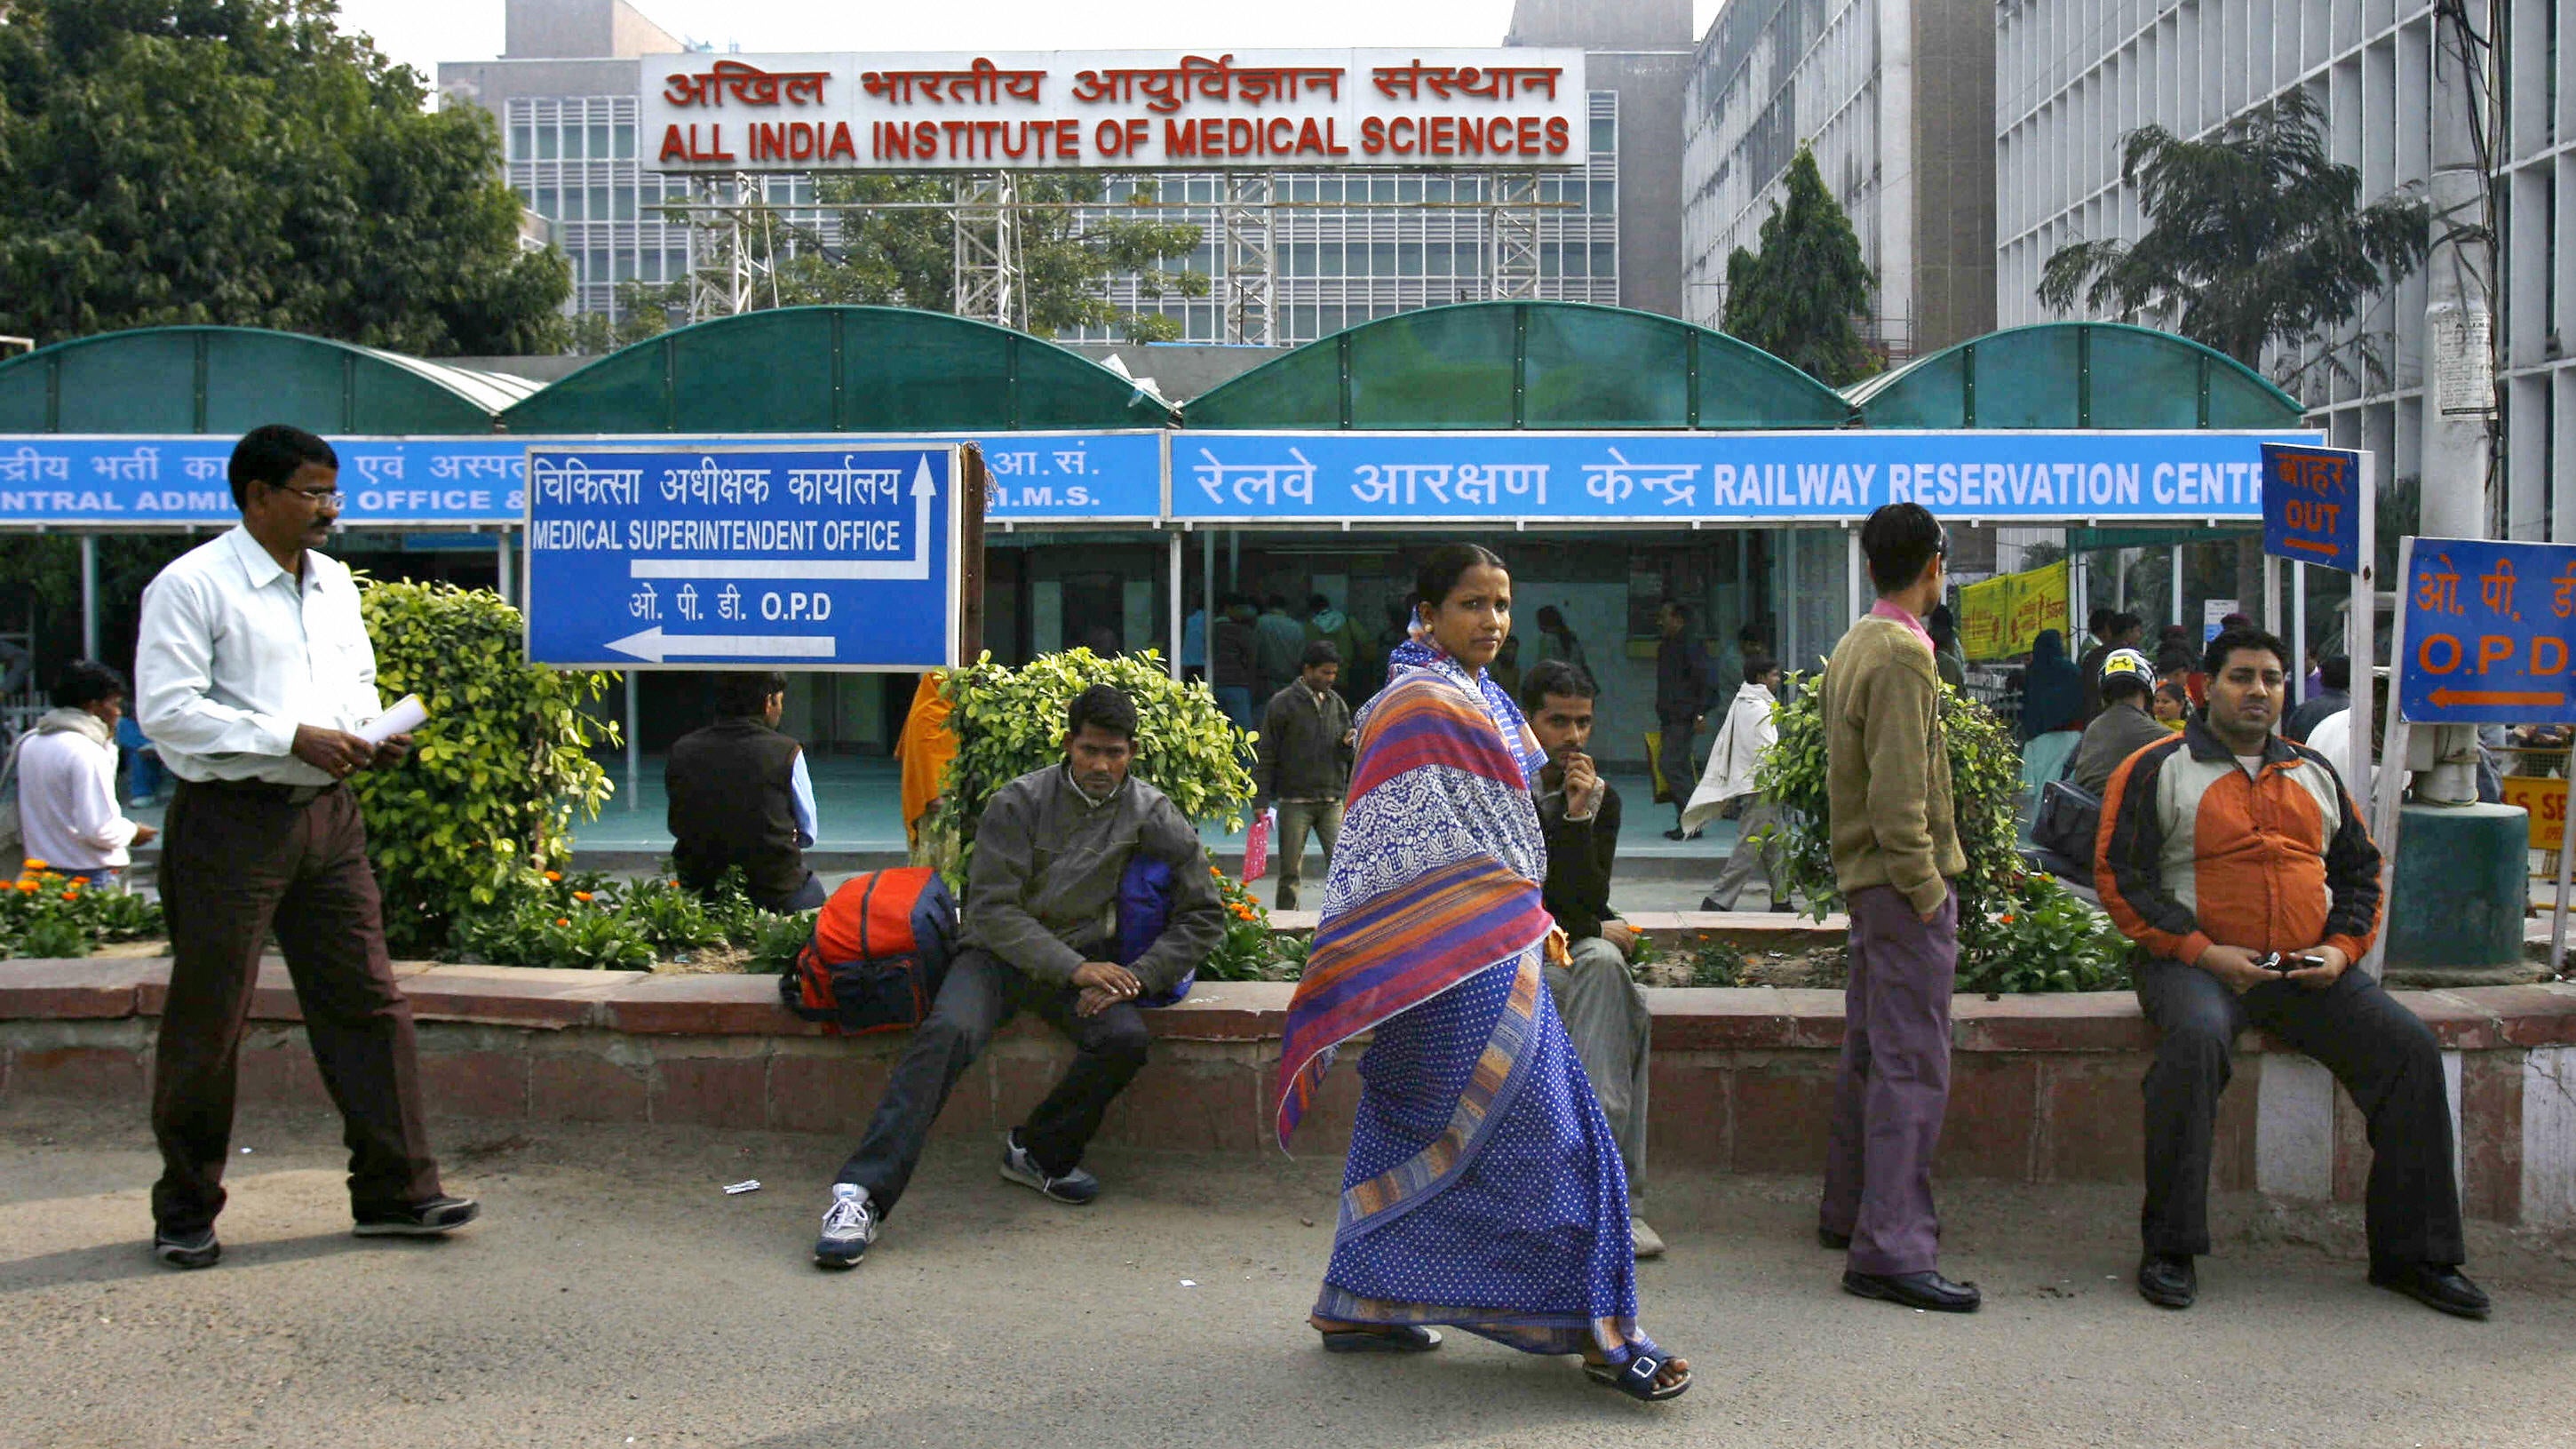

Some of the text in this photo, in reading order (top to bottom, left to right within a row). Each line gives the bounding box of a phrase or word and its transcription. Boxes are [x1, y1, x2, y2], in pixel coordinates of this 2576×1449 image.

[664, 54, 1562, 112] अखिल भारतीय आयुर्विज्ञान संस्थान
[660, 116, 1570, 161] ALL INDIA INSTITUTE OF MEDICAL SCIENCES
[91, 447, 160, 480] भर्ती
[354, 445, 405, 484] एवं
[533, 454, 902, 506] चिकित्सा अधीक्षक कार्यालय
[1193, 447, 1702, 506] रेलवे आरक्षण केन्द्र
[1714, 464, 1877, 506] RAILWAY
[1888, 463, 2140, 506] RESERVATION
[2276, 453, 2348, 497] बाहर
[358, 490, 490, 511] OFFICE
[2285, 499, 2341, 534] OUT
[533, 520, 900, 551] MEDICAL SUPERINTENDENT OFFICE
[676, 583, 704, 621] पी.
[761, 592, 831, 621] O.P.D
[2480, 557, 2521, 622] पी.
